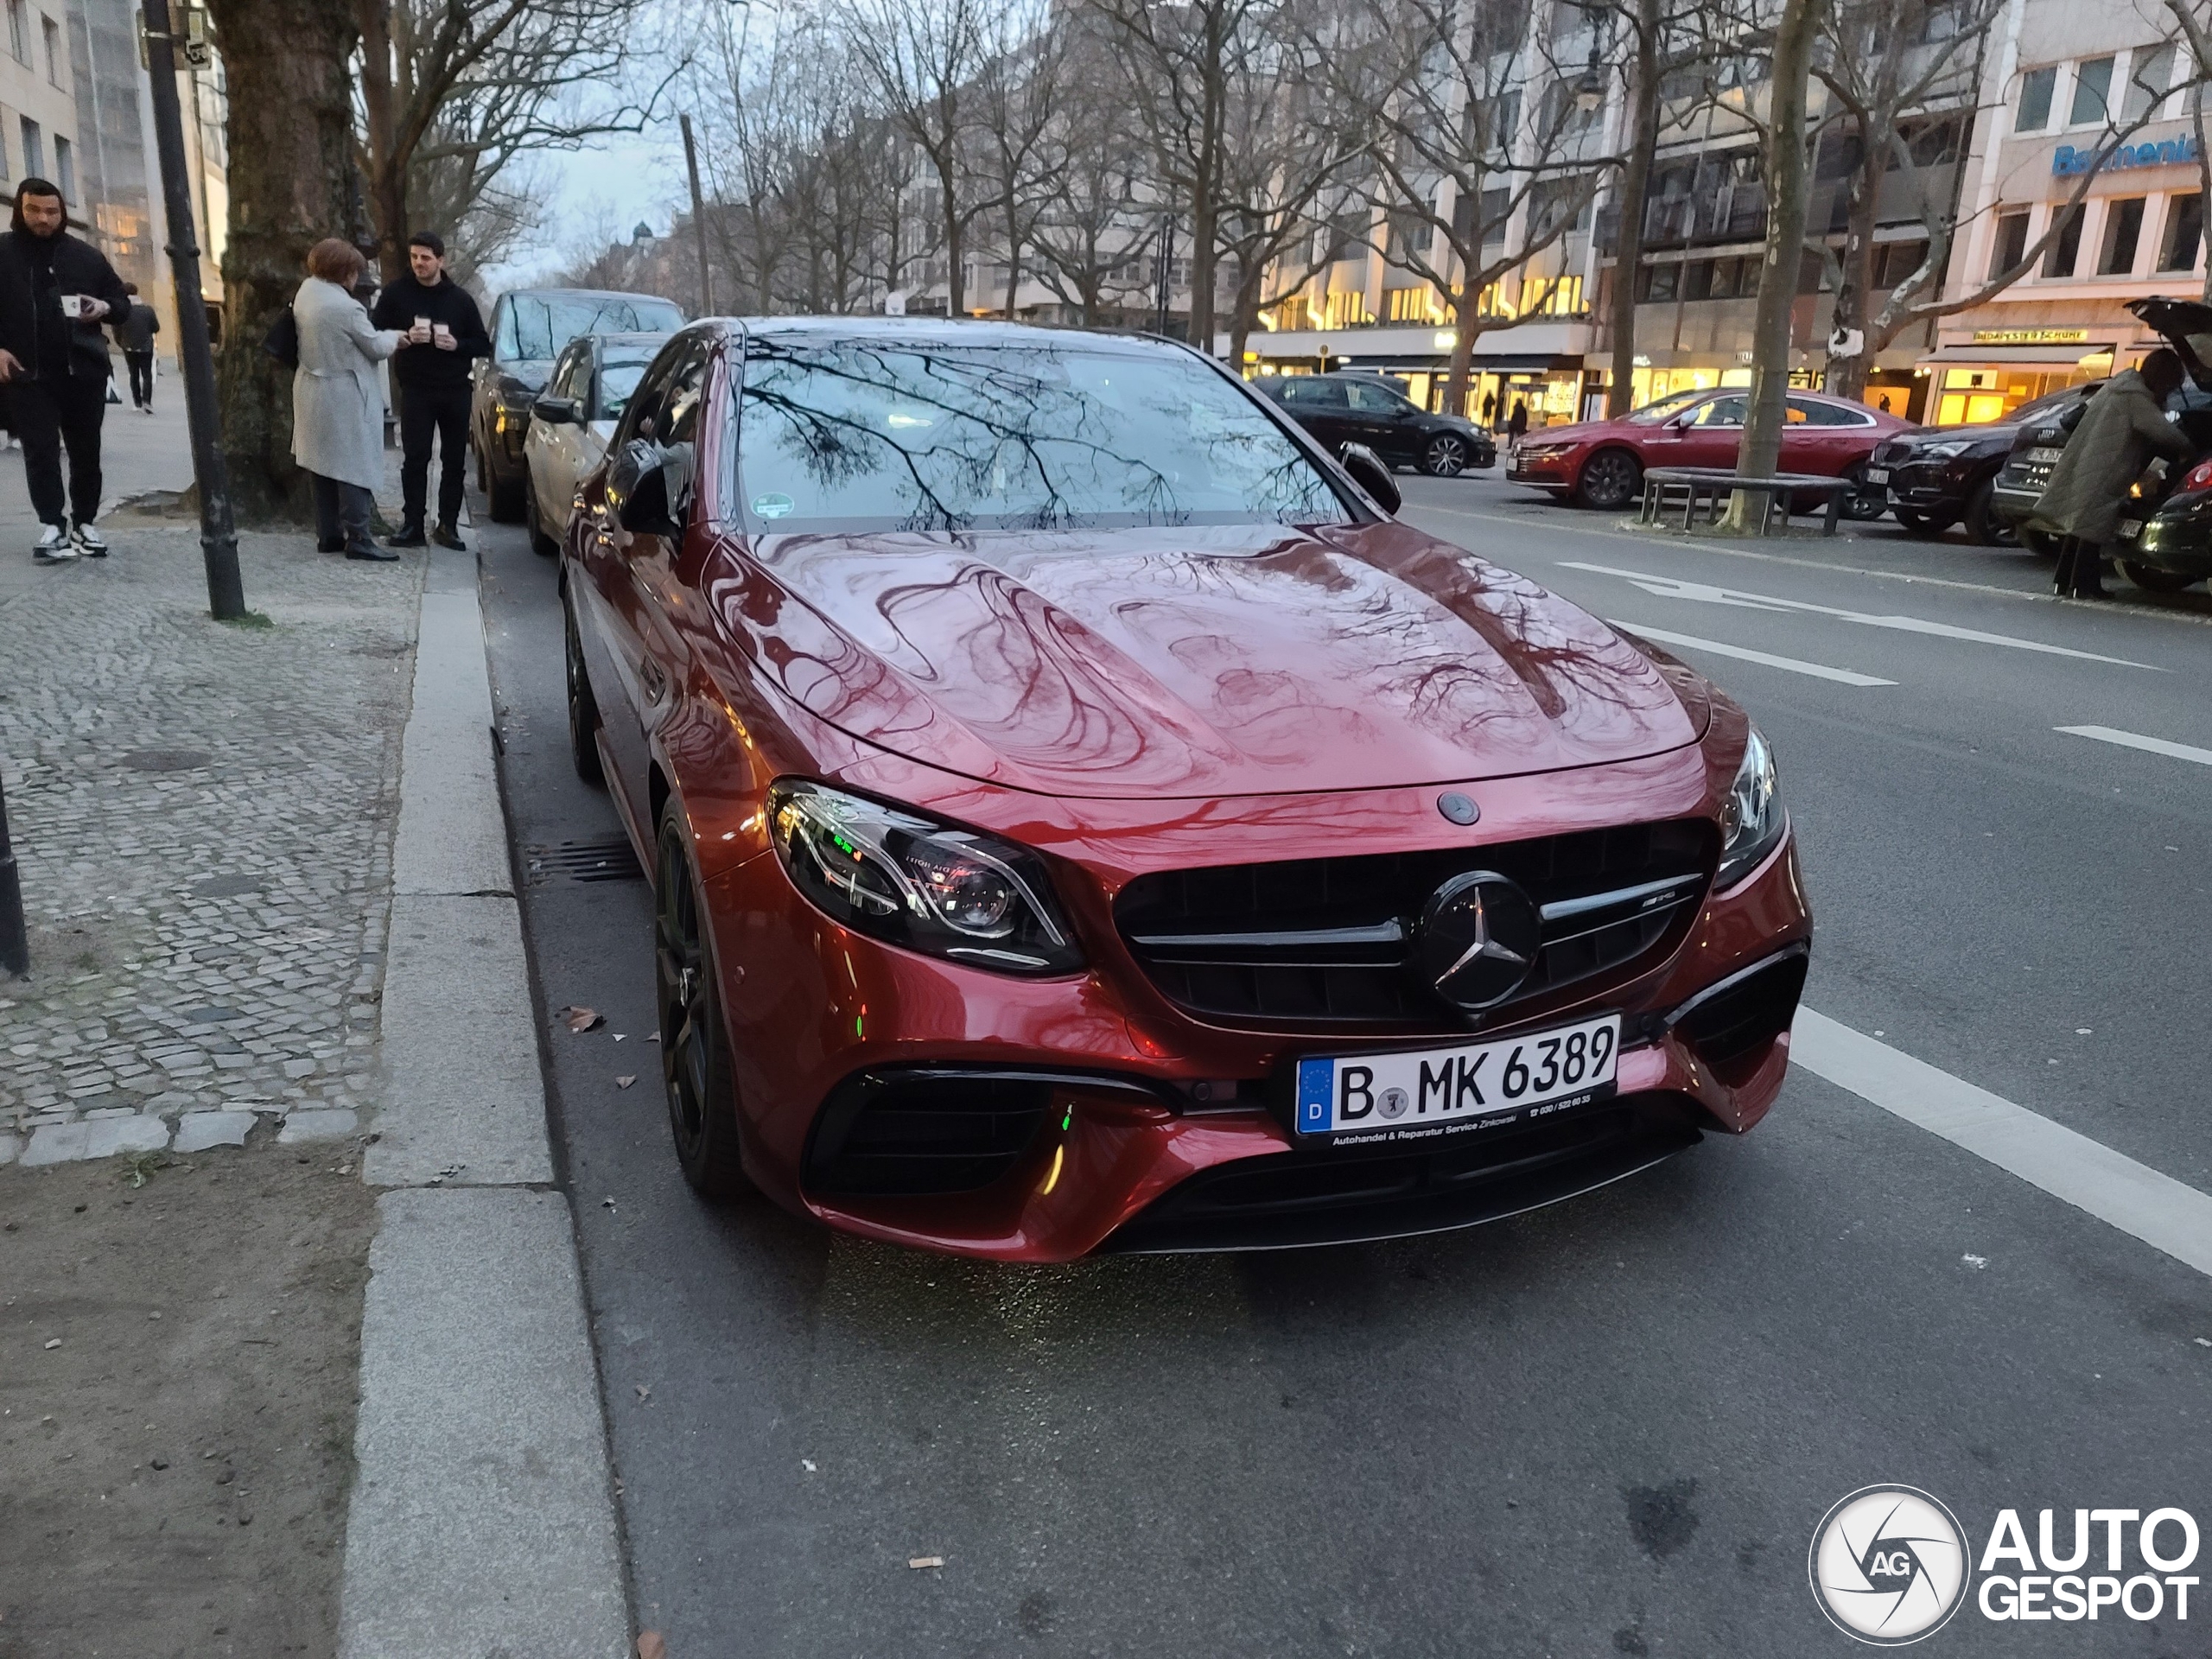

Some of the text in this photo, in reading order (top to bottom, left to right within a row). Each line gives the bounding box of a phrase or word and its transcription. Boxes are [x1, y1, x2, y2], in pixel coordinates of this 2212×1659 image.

[1340, 1025, 1615, 1121] B MK 6389
[1309, 1103, 1322, 1120] D
[1332, 1132, 1386, 1147] Autohandel
[1388, 1132, 1396, 1141] &
[1398, 1128, 1445, 1140] Reparatur
[1446, 1122, 1478, 1135] Service
